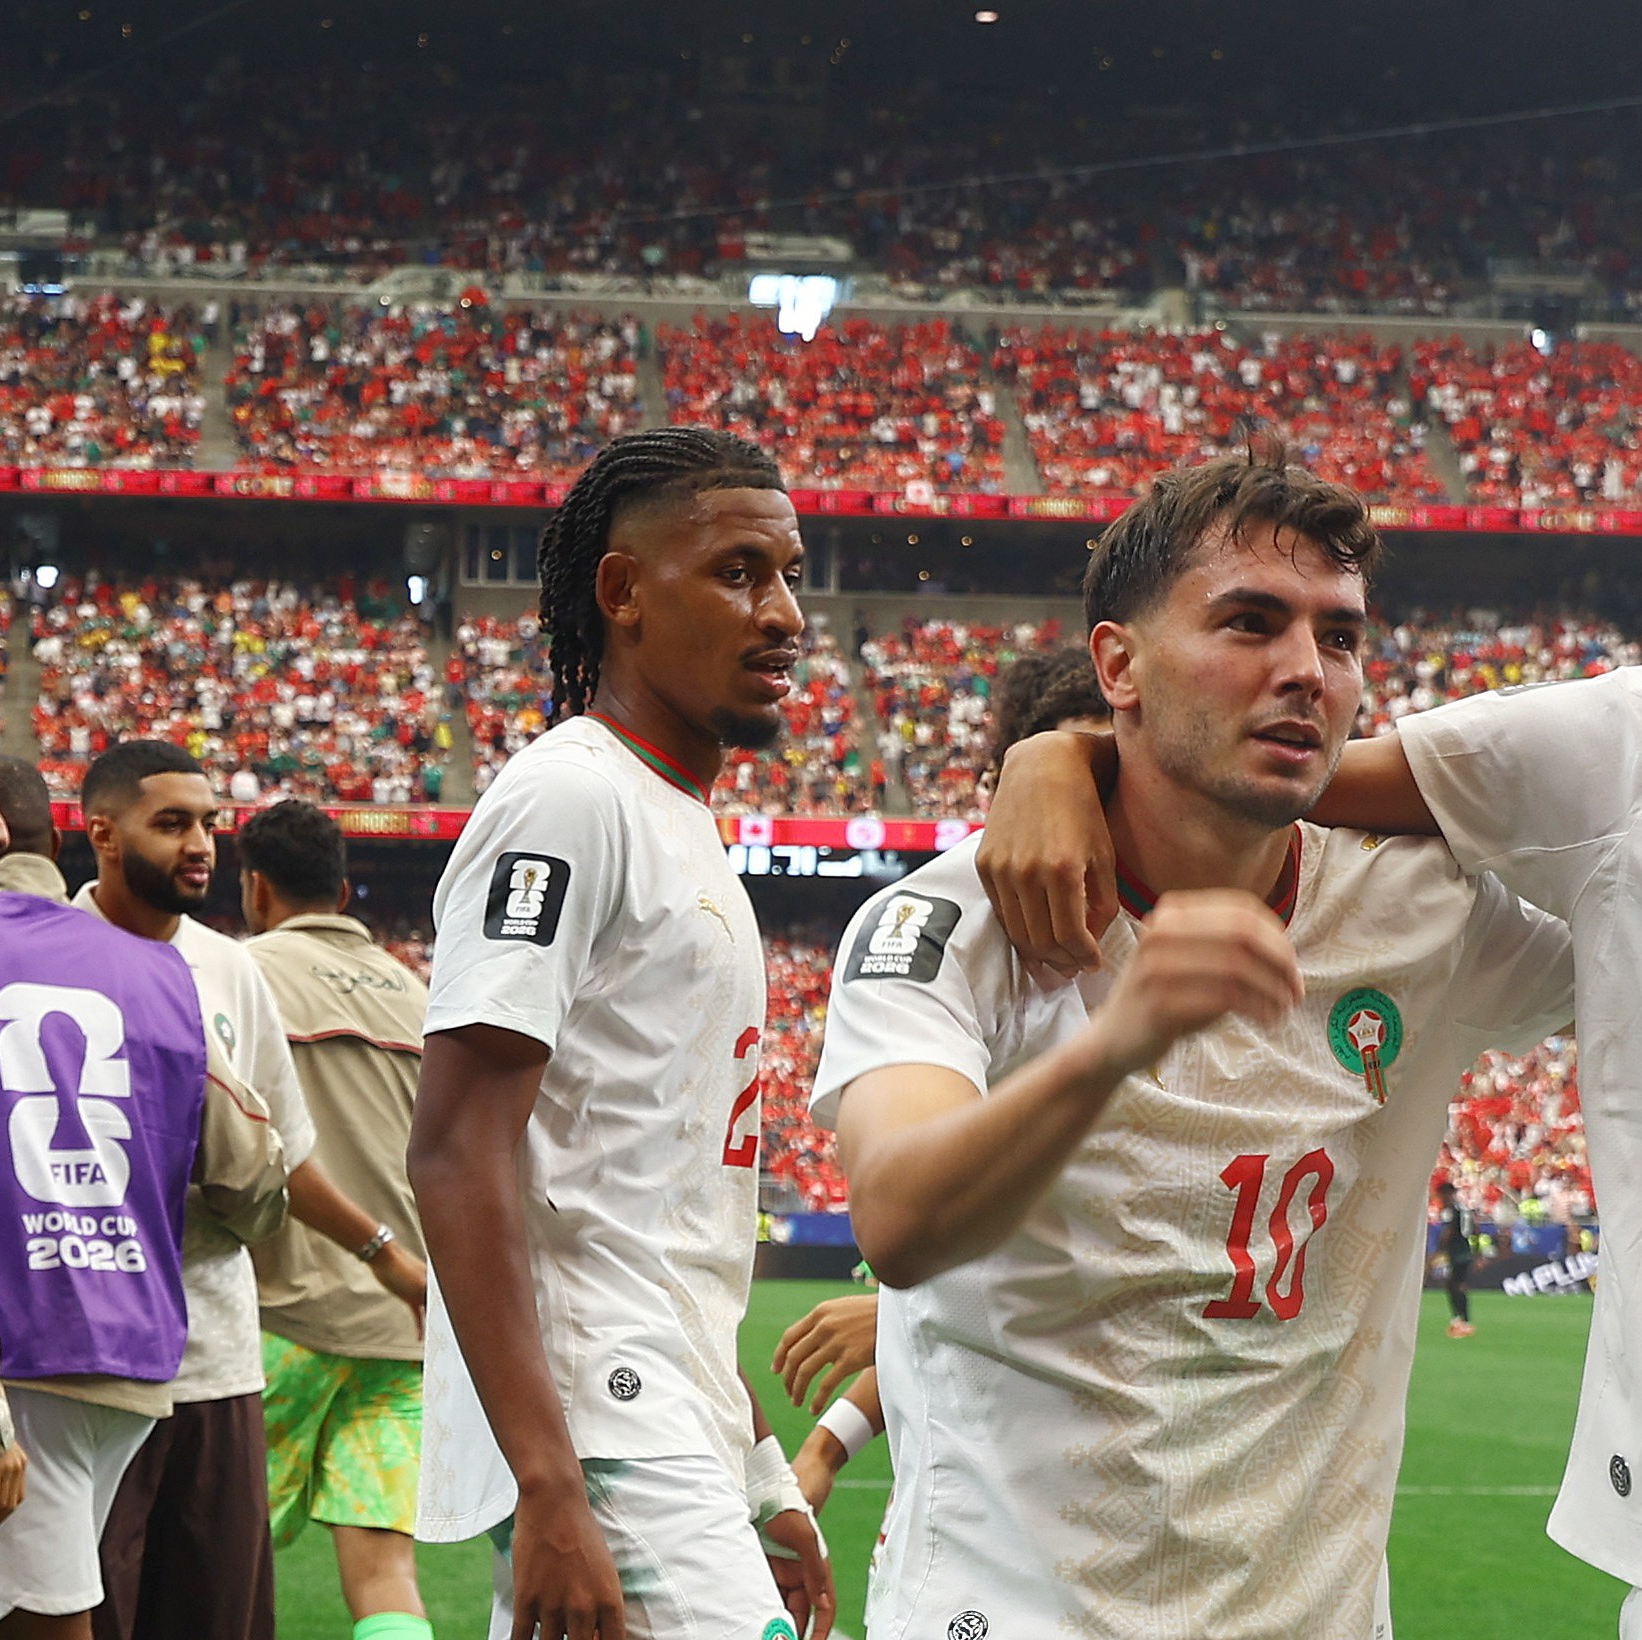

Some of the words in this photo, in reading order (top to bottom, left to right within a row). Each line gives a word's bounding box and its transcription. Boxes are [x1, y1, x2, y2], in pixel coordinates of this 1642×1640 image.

[501, 926, 536, 936] 2026
[881, 940, 903, 949] FIFA
[860, 962, 909, 974] 2026
[50, 1163, 107, 1185] FIFA
[1202, 1148, 1335, 1320] 10
[26, 1234, 147, 1273] 2026
